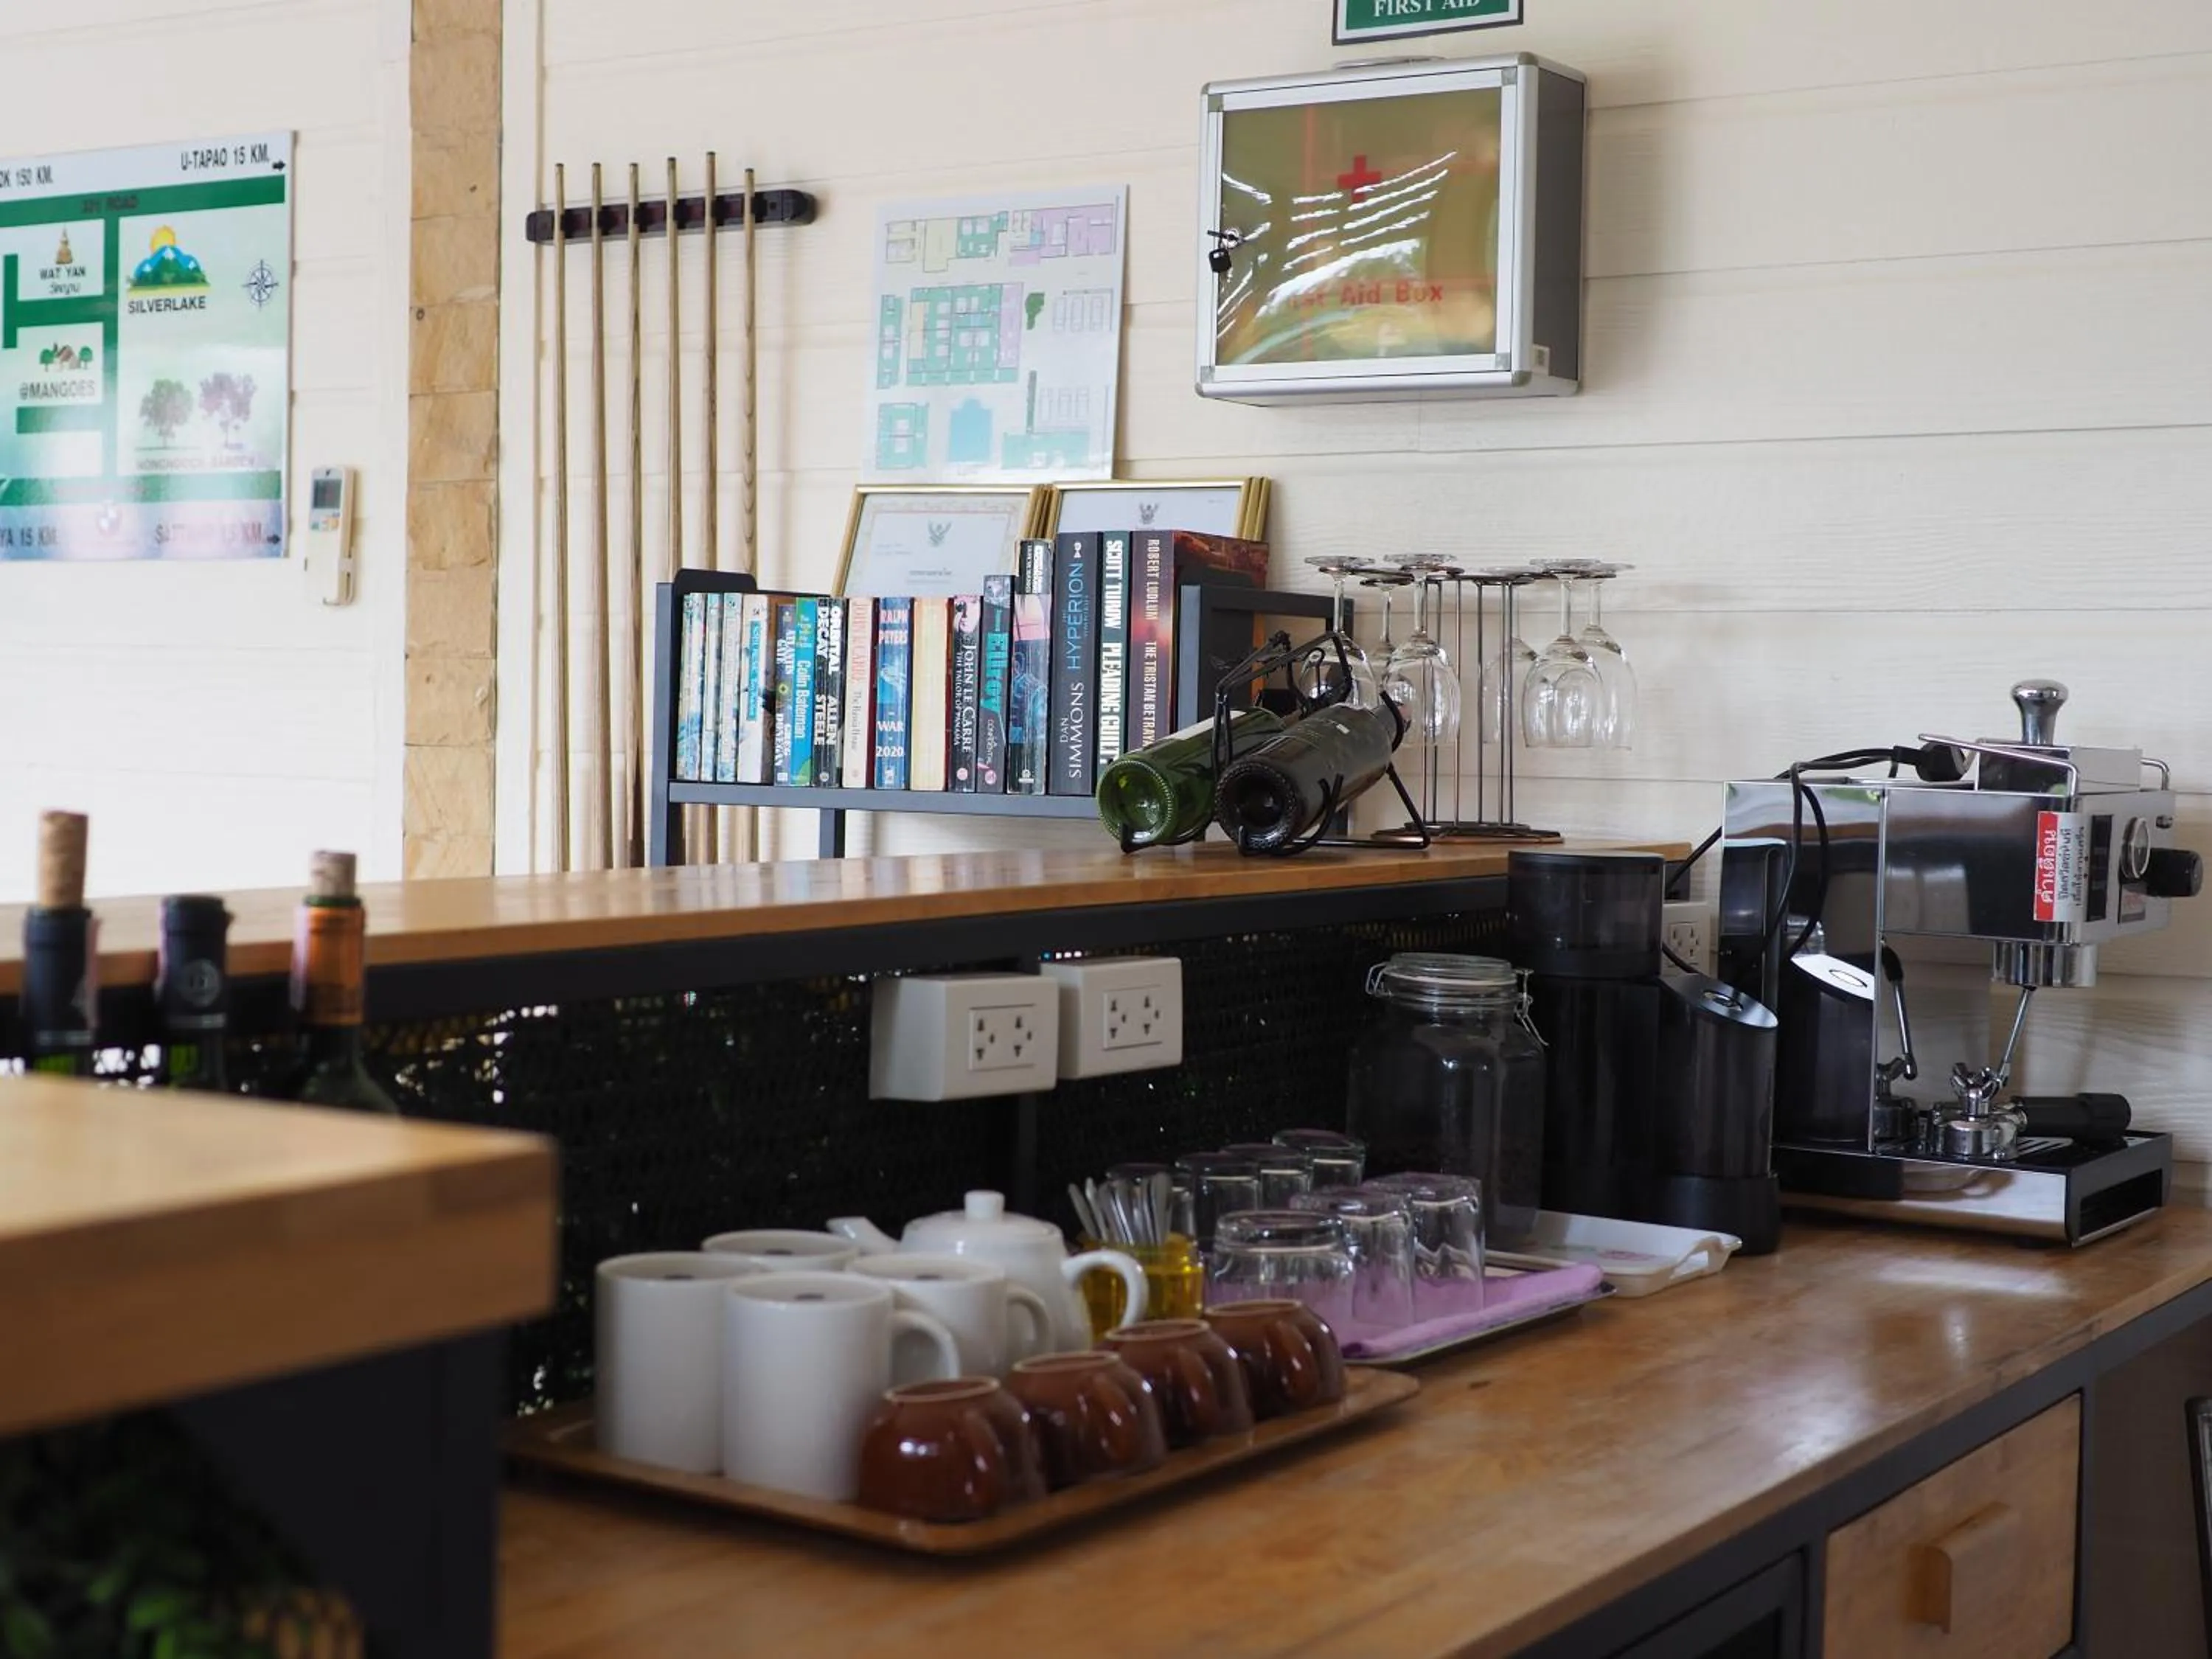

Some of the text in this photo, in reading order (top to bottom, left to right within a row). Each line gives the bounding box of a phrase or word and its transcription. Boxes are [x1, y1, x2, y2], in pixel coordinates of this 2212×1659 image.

[181, 147, 227, 170] U-TAPAO
[233, 146, 246, 165] 15
[39, 265, 86, 279] WAT YAN
[128, 296, 206, 313] SILVERLAKE
[19, 379, 96, 401] @MANGOES
[21, 527, 32, 546] 15
[1104, 540, 1122, 629] SCOTT TUROW
[1145, 539, 1160, 620] ROBERT LUDLUM
[816, 606, 828, 658] DECAY
[1067, 563, 1083, 669] HYPERION
[829, 606, 841, 675] ORBITAL
[964, 644, 976, 684] JOHN
[796, 660, 811, 687] Colin
[963, 688, 973, 703] LE
[981, 633, 1009, 714] Ellroy
[1100, 642, 1121, 712] PLEADING
[1141, 641, 1157, 748] THE TRISTAN BETRAYA
[794, 690, 810, 738] Bateman
[814, 694, 826, 745] STEELE
[826, 696, 838, 745] ALLEN
[877, 720, 904, 732] WAR
[1060, 717, 1068, 742] DAN
[1068, 682, 1084, 779] SIMMONS
[876, 745, 904, 757] 2020
